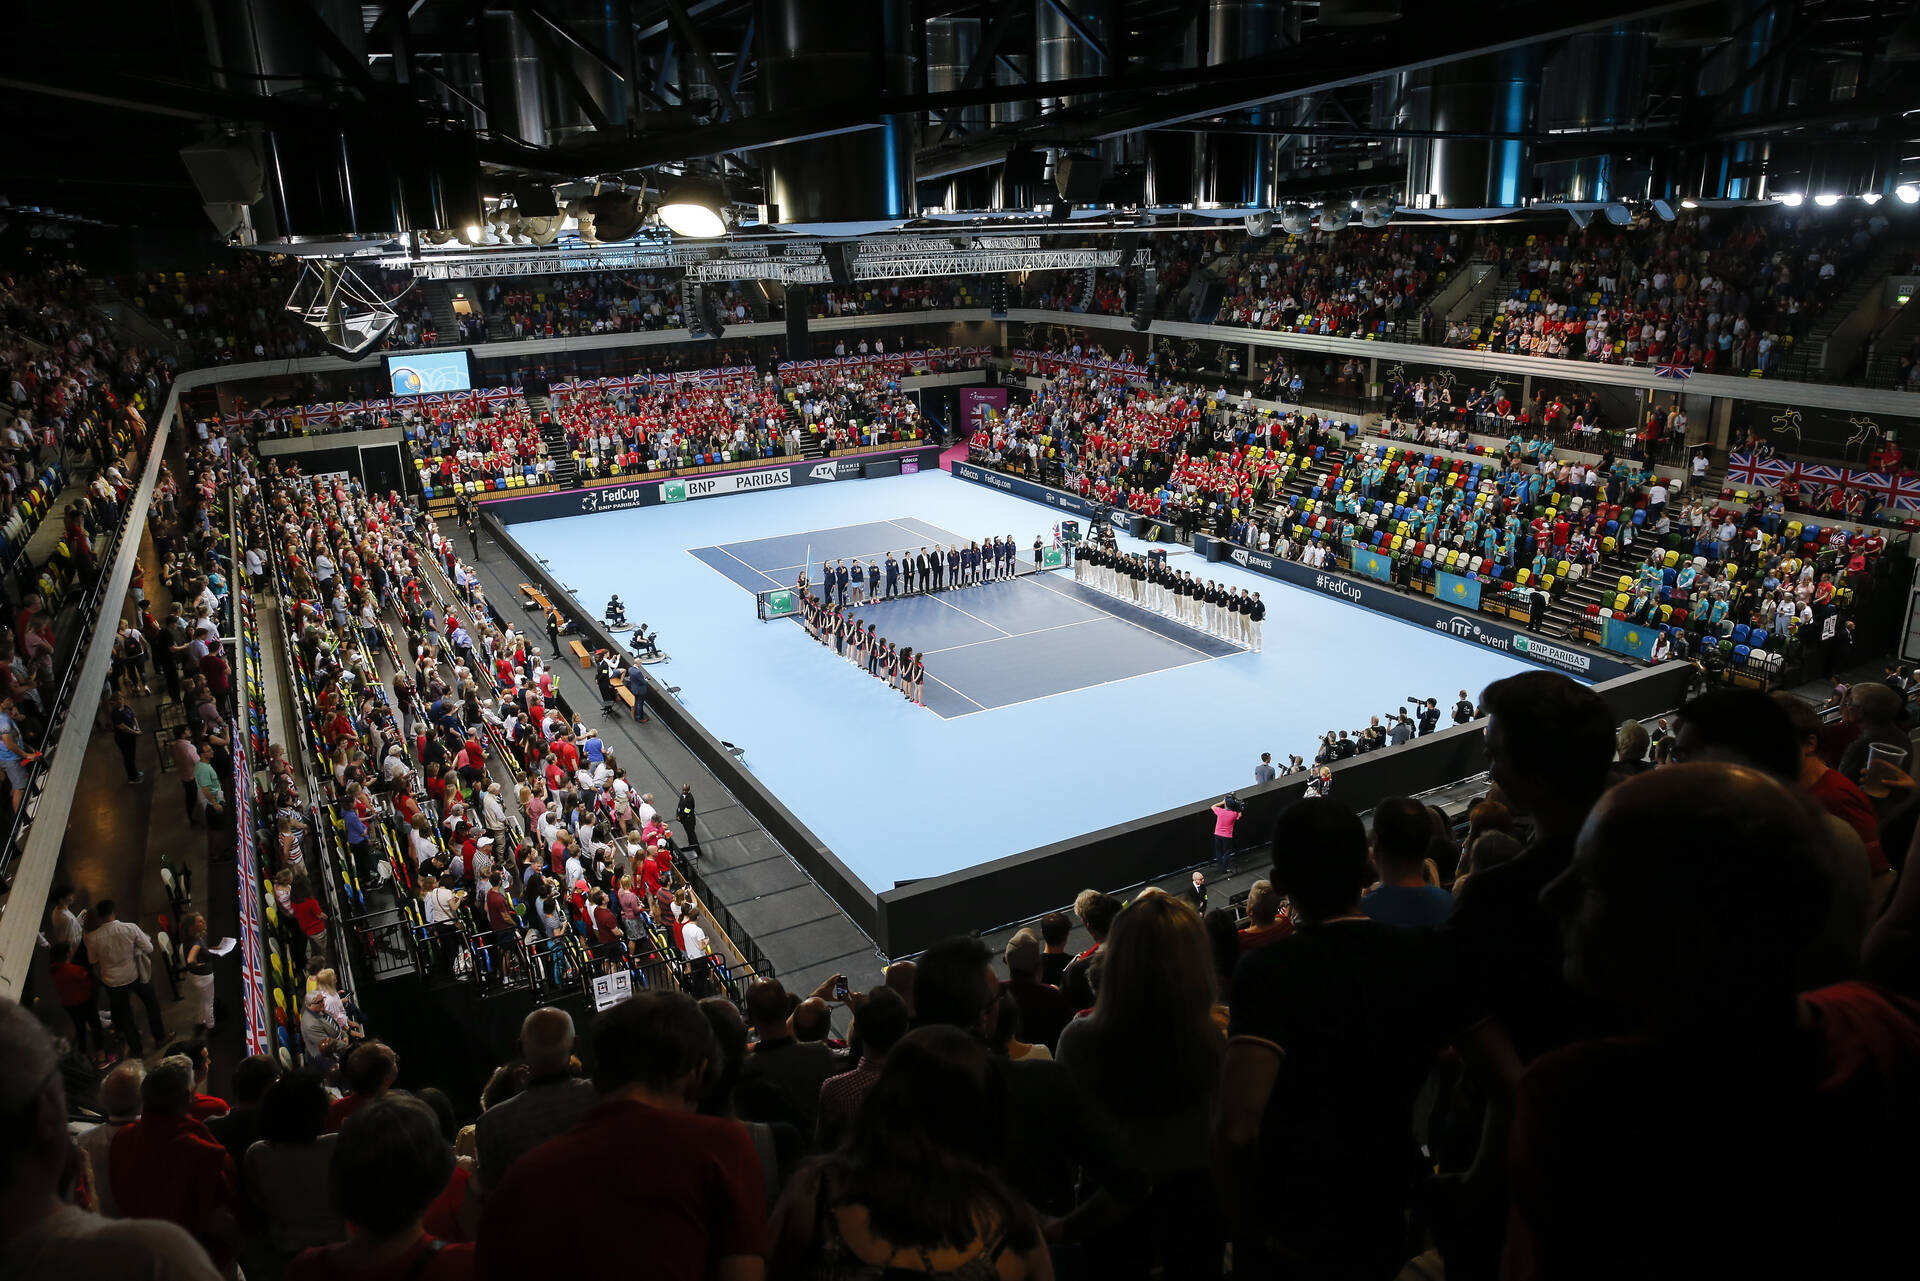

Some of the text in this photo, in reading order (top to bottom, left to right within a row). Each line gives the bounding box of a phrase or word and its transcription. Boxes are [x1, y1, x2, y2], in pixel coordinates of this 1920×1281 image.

[816, 467, 835, 477] LTA
[838, 462, 860, 470] TENNIS
[689, 472, 789, 495] BNP PARIBAS
[960, 466, 1012, 489] Adecco FedCup.com
[602, 488, 640, 502] FedCup
[613, 501, 640, 510] PARIBAS
[1249, 556, 1272, 569] SERVES
[1317, 575, 1361, 602] #FedCup
[1436, 620, 1509, 650] an ITF event
[1530, 642, 1585, 666] BNP PARIBAS
